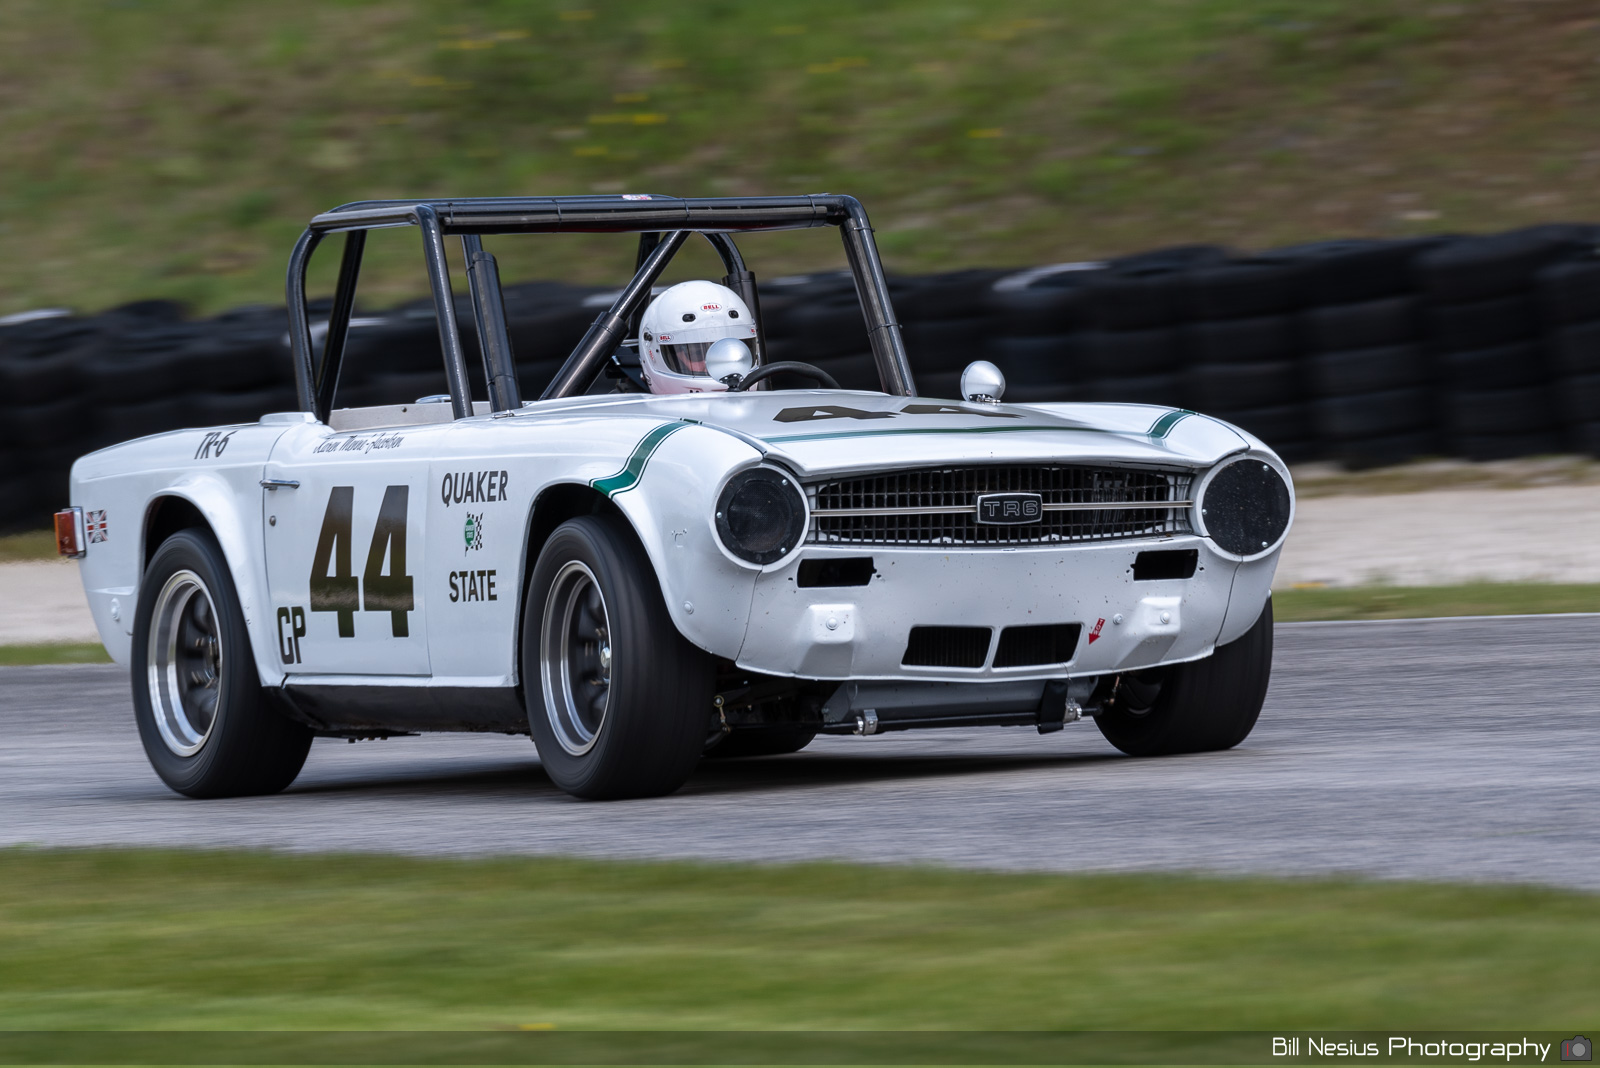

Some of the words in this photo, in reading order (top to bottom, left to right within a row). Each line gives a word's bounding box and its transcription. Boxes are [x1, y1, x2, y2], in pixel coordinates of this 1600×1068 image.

[194, 430, 238, 460] TR-6
[441, 470, 508, 508] QUAKER
[983, 500, 1038, 517] TR6
[309, 485, 414, 638] 44
[449, 569, 498, 603] STATE
